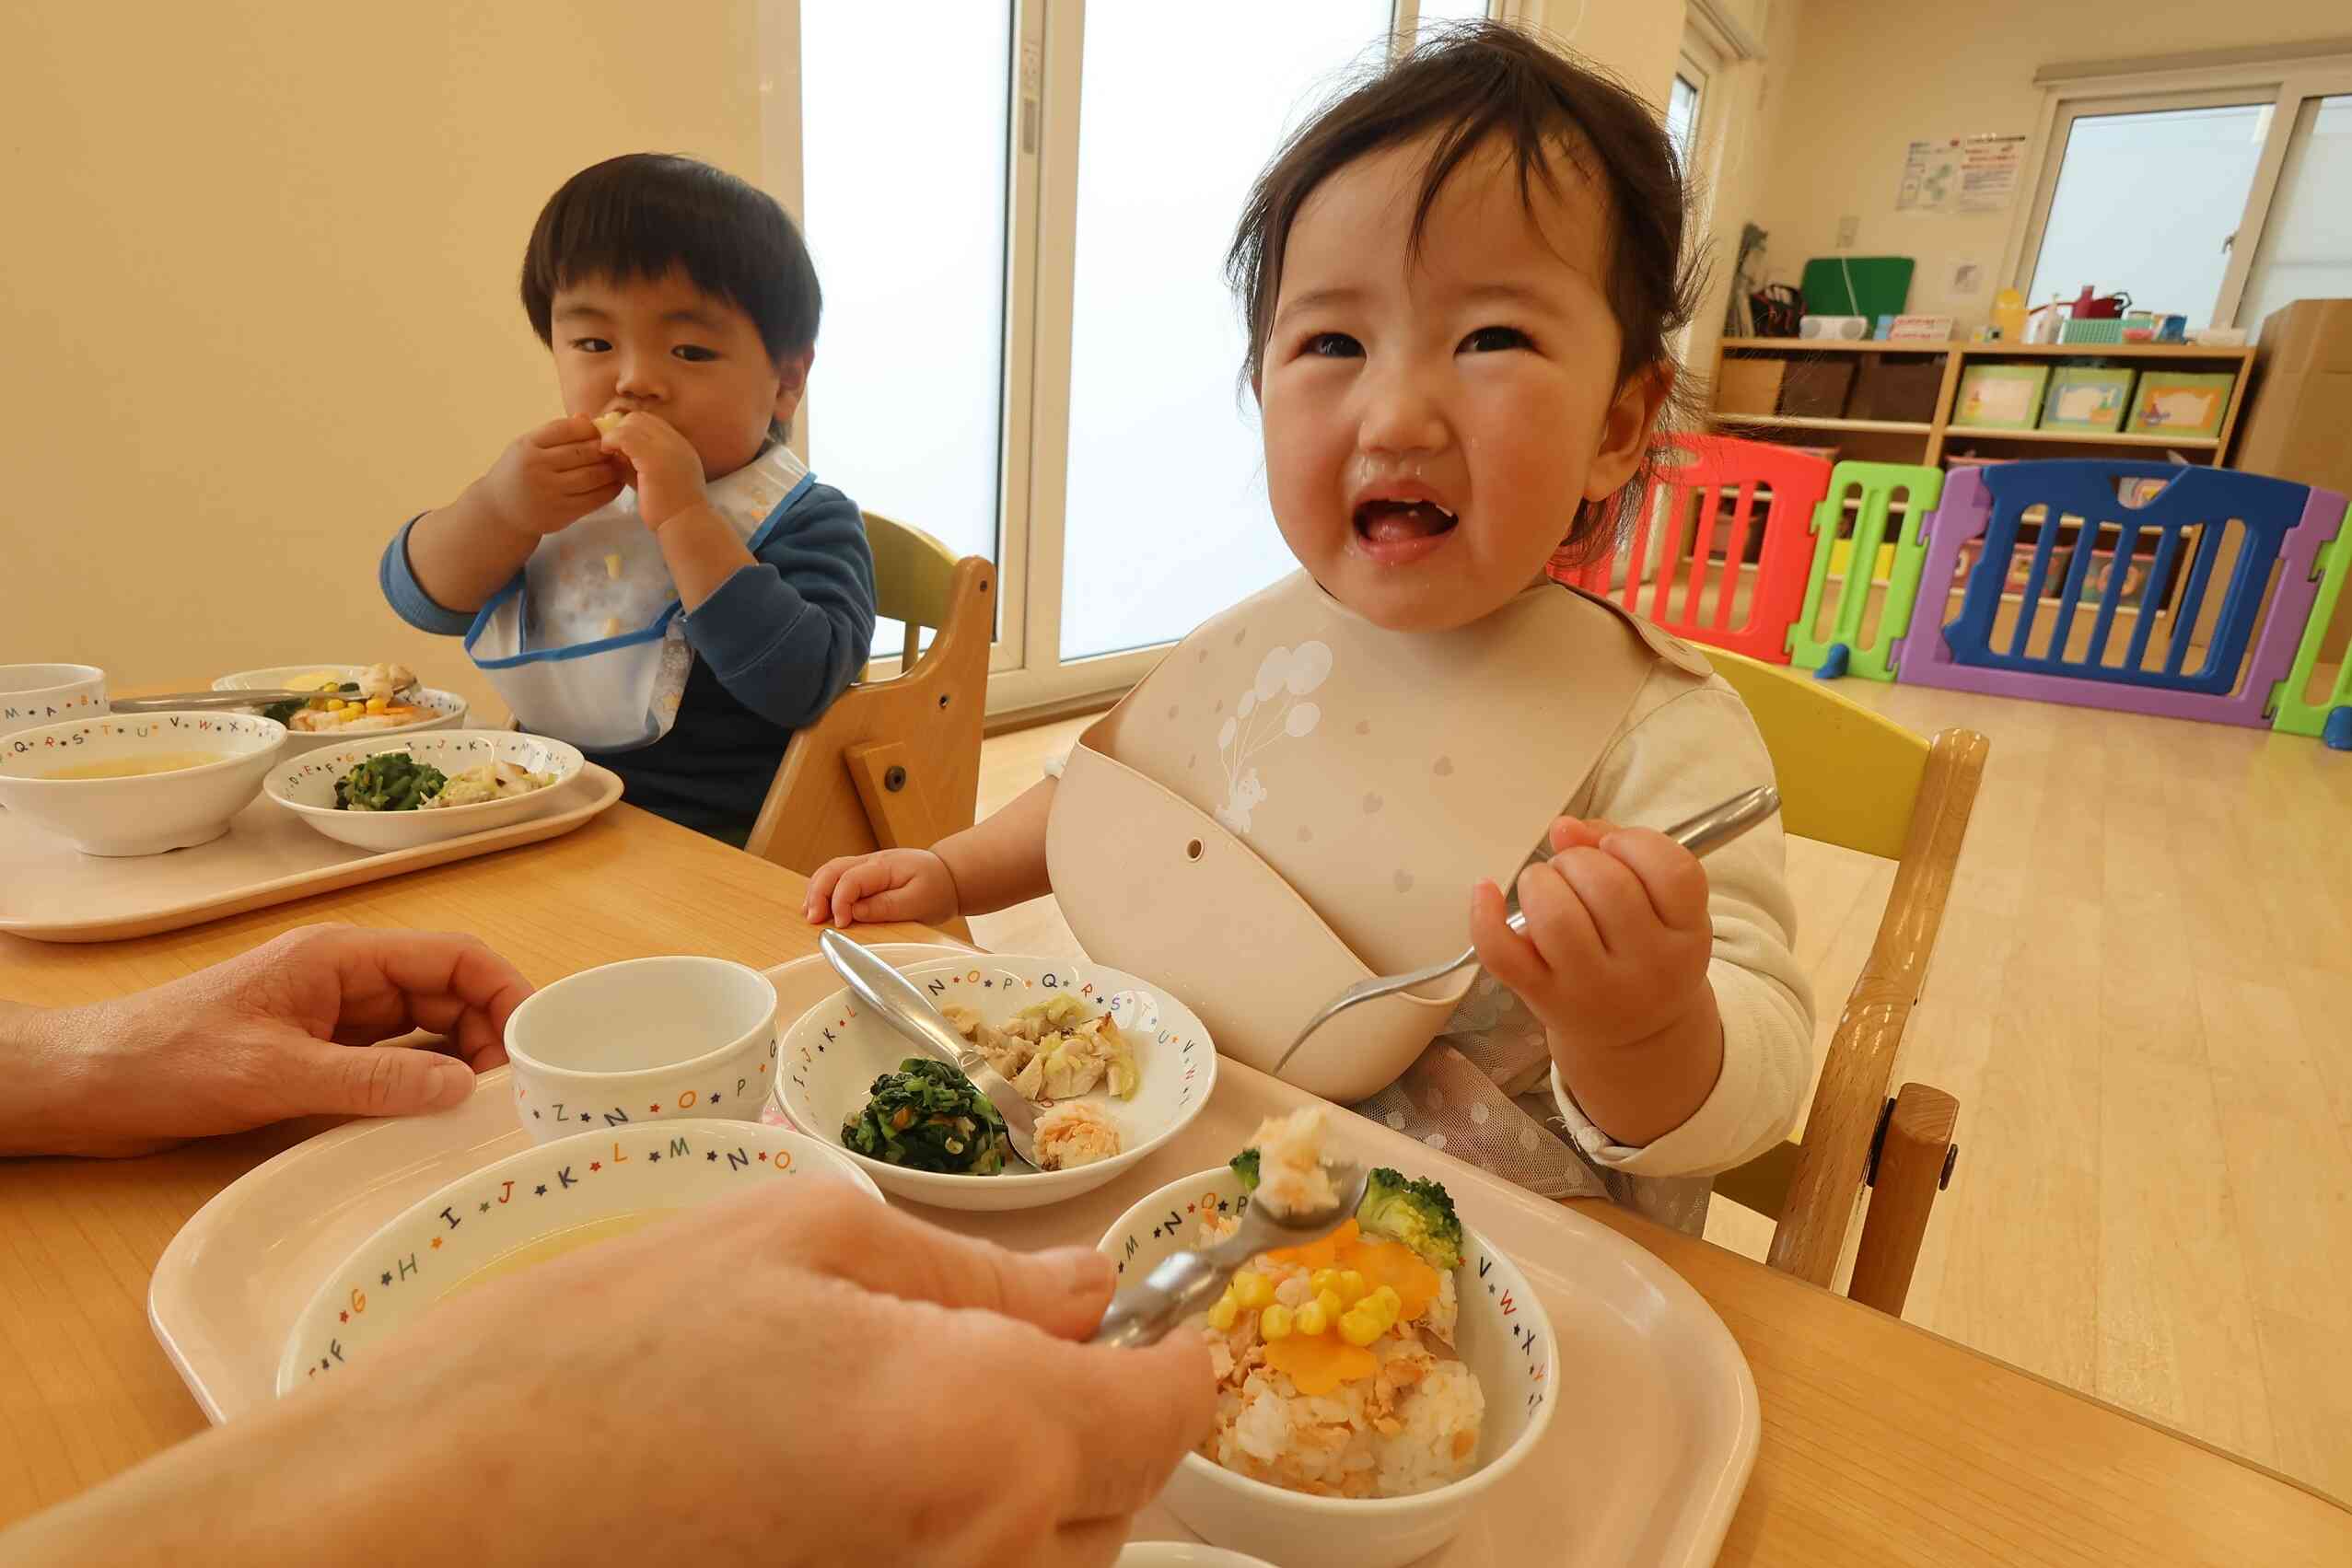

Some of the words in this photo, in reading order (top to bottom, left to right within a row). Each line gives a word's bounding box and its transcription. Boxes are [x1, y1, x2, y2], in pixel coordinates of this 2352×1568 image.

[5, 707, 20, 718] M
[46, 706, 57, 717] A
[14, 741, 29, 752] Q
[44, 736, 55, 748] R
[72, 734, 84, 745] S
[102, 725, 111, 735] T
[136, 727, 147, 738] U
[169, 715, 180, 727] V
[229, 722, 239, 732] X
[469, 740, 477, 751] K
[822, 1027, 836, 1043] K
[927, 979, 945, 995] N
[967, 970, 981, 983] O
[1002, 978, 1013, 990] P
[1042, 973, 1057, 988] Q
[1081, 982, 1093, 997] R
[1111, 996, 1120, 1011] S
[1159, 1029, 1170, 1044] U
[1182, 1038, 1196, 1052] V
[552, 1104, 569, 1121] Z
[604, 1108, 628, 1126] N
[679, 1090, 696, 1109] O
[737, 1079, 746, 1097] P
[331, 1338, 344, 1363] F
[351, 1288, 366, 1313] G
[398, 1252, 417, 1281] H
[439, 1206, 461, 1229] I
[498, 1180, 515, 1203] J
[558, 1166, 579, 1189] K
[612, 1143, 628, 1163] L
[670, 1137, 690, 1158] M
[727, 1147, 750, 1171] N
[774, 1151, 791, 1169] O
[1124, 1235, 1139, 1260] M
[1163, 1211, 1182, 1236] N
[1201, 1192, 1217, 1210] O
[1237, 1195, 1249, 1214] P
[1479, 1256, 1492, 1279] V
[1521, 1329, 1536, 1356] X
